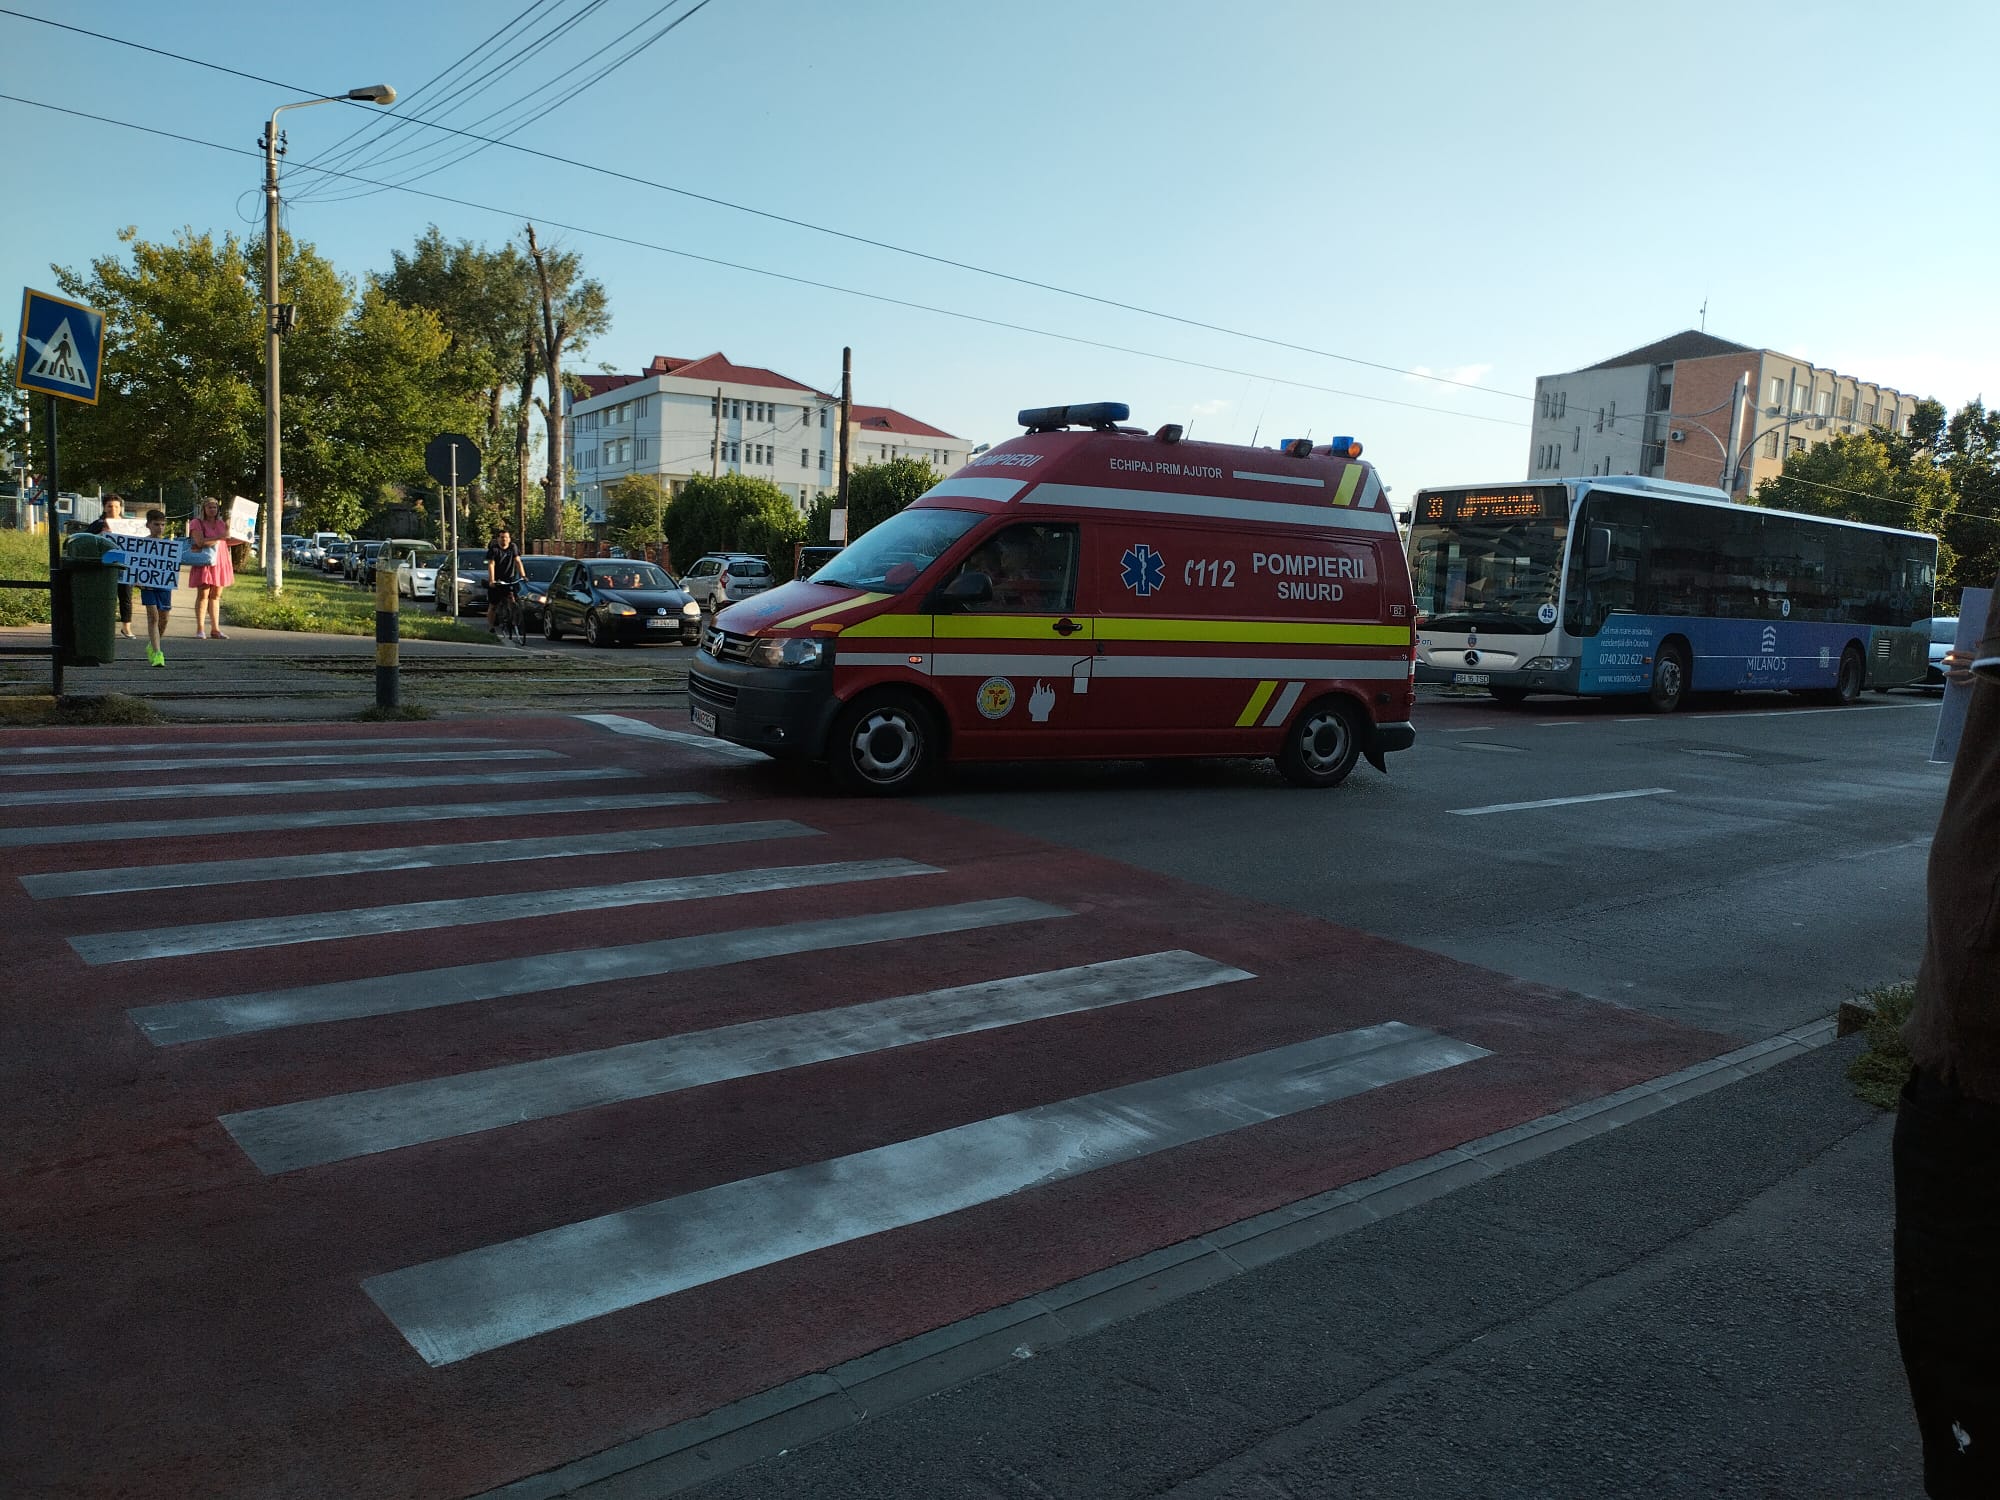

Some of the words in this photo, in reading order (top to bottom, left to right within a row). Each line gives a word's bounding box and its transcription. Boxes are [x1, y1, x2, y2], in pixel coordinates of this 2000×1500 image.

[1110, 458, 1153, 473] ECHIPAJ
[1155, 462, 1181, 476] PRIM
[1183, 465, 1222, 479] AJUTOR
[130, 556, 181, 573] PENTRU
[1195, 559, 1236, 588] 112
[1252, 552, 1364, 579] POMPIERII
[1277, 581, 1344, 602] SMURD
[1541, 608, 1553, 618] 45
[1599, 653, 1617, 665] 0740
[1617, 653, 1630, 665] 202
[1630, 653, 1643, 665] 622
